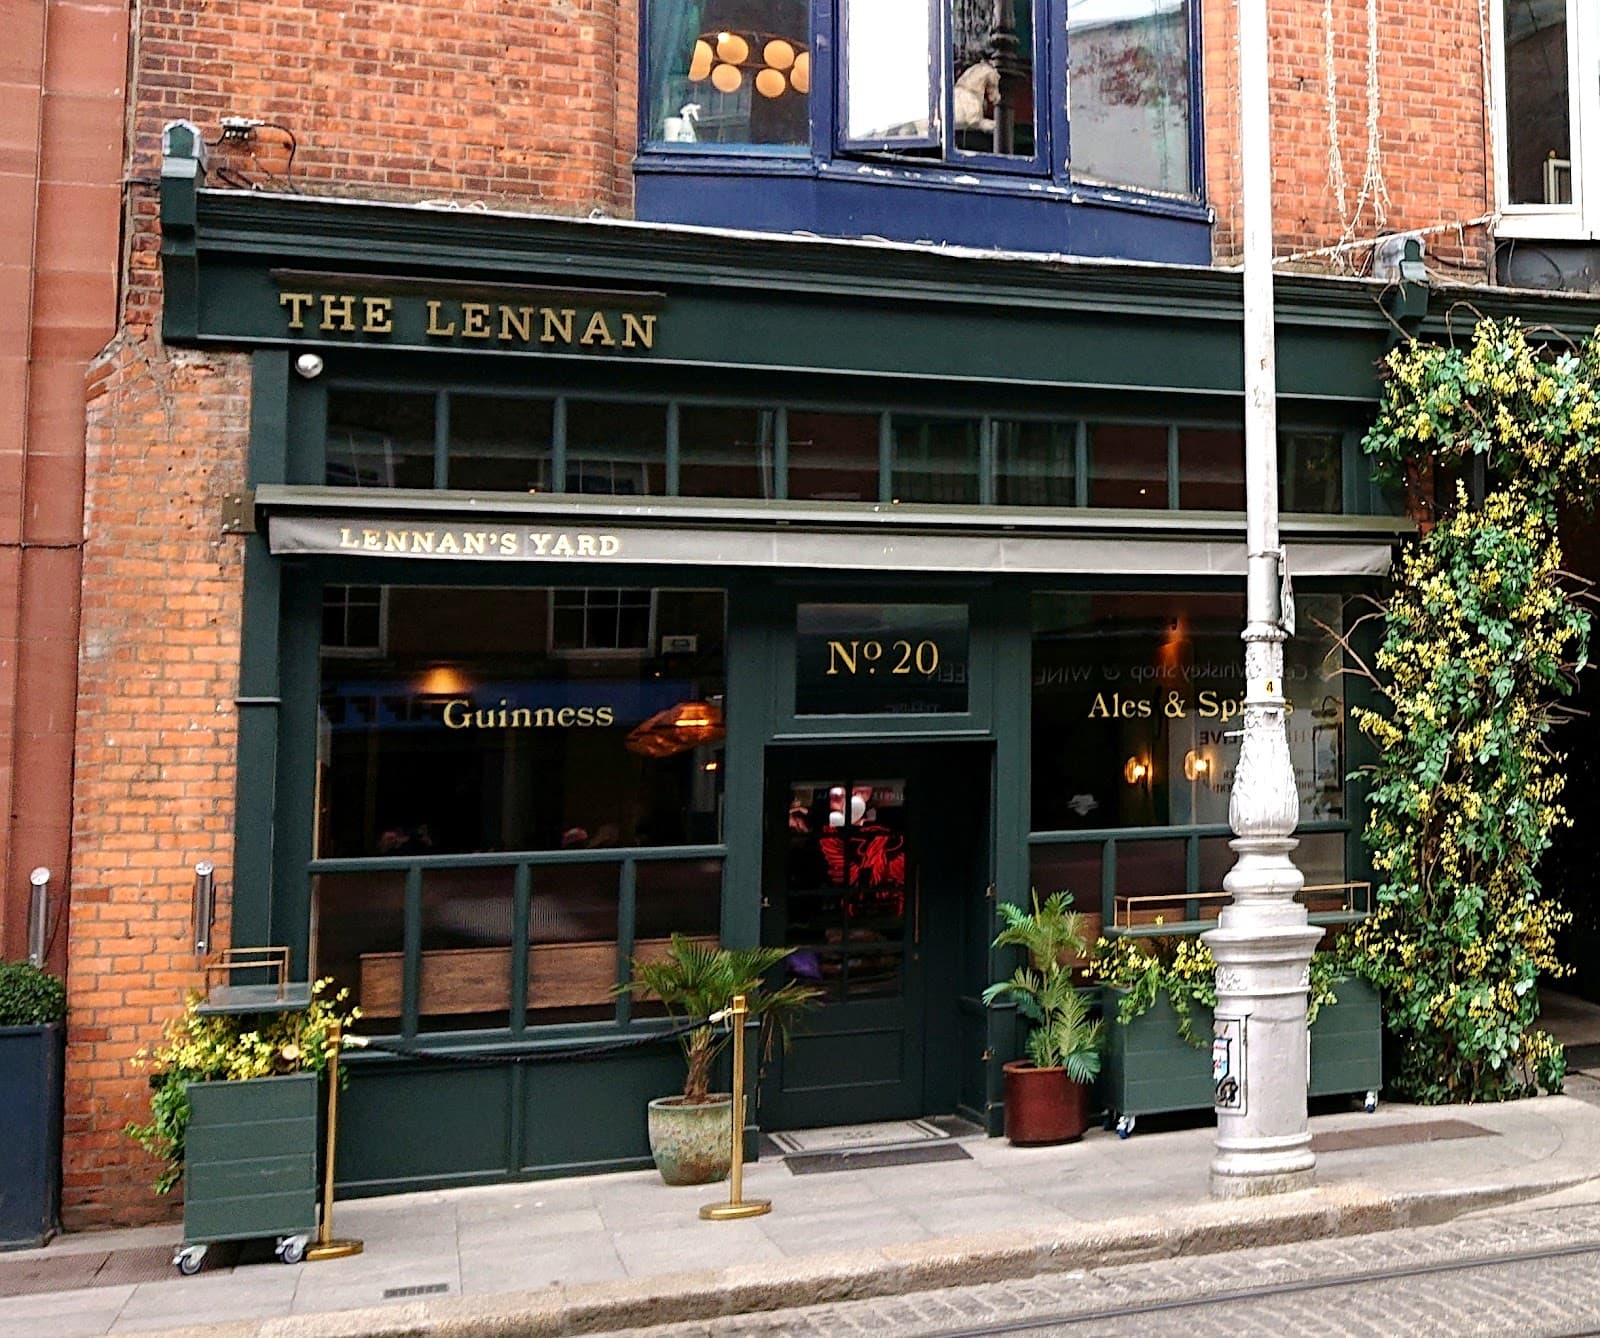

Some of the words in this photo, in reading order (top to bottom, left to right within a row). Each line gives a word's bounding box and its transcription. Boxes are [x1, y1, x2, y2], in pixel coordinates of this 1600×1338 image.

[280, 292, 393, 334] THE
[426, 300, 657, 349] LENNAN
[340, 528, 518, 555] LENNAN'S
[529, 533, 620, 557] YARD
[892, 640, 939, 675] 20
[443, 699, 614, 729] Guinness
[1088, 692, 1152, 718] Ales
[1164, 691, 1187, 718] &
